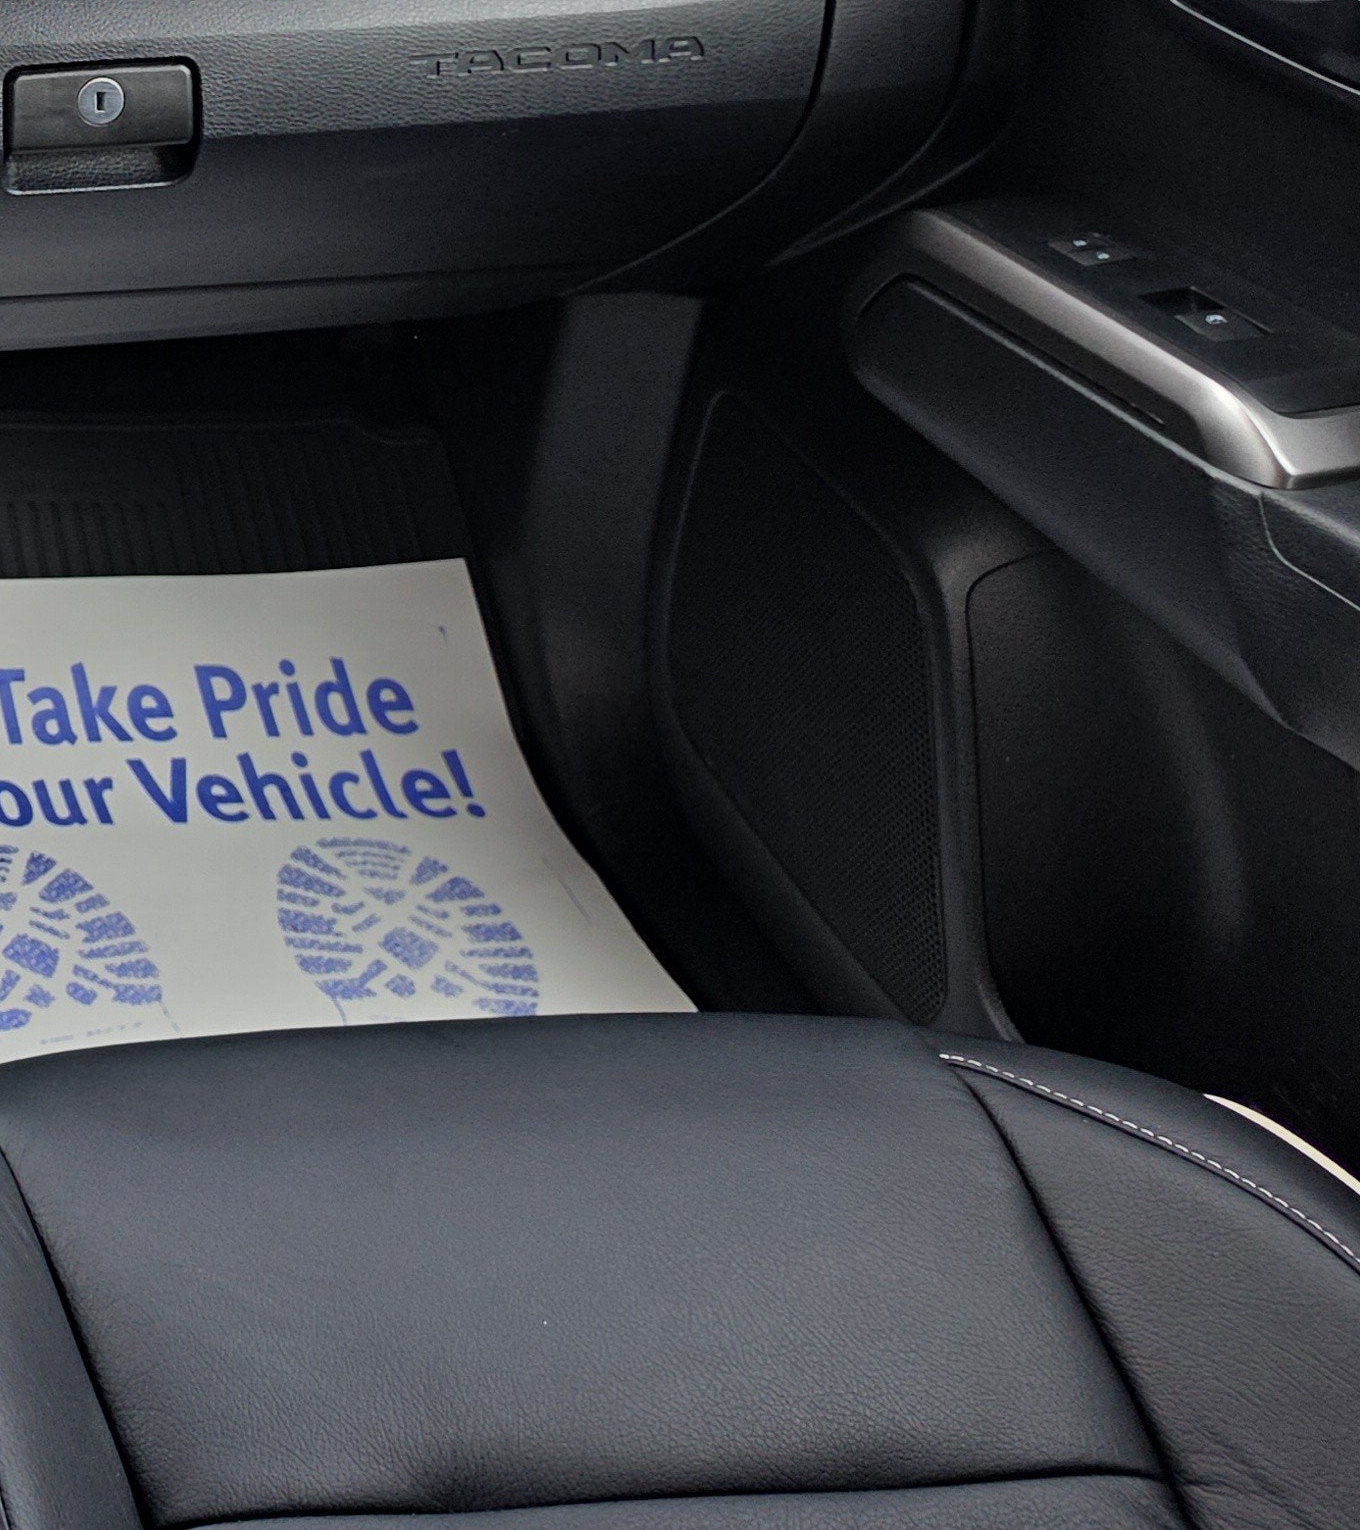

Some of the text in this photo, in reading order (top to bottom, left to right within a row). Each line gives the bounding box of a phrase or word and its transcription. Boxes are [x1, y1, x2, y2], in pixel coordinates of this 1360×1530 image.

[408, 35, 705, 79] TACOMA
[195, 654, 419, 743] Pride
[126, 747, 488, 827] Vehicle!
